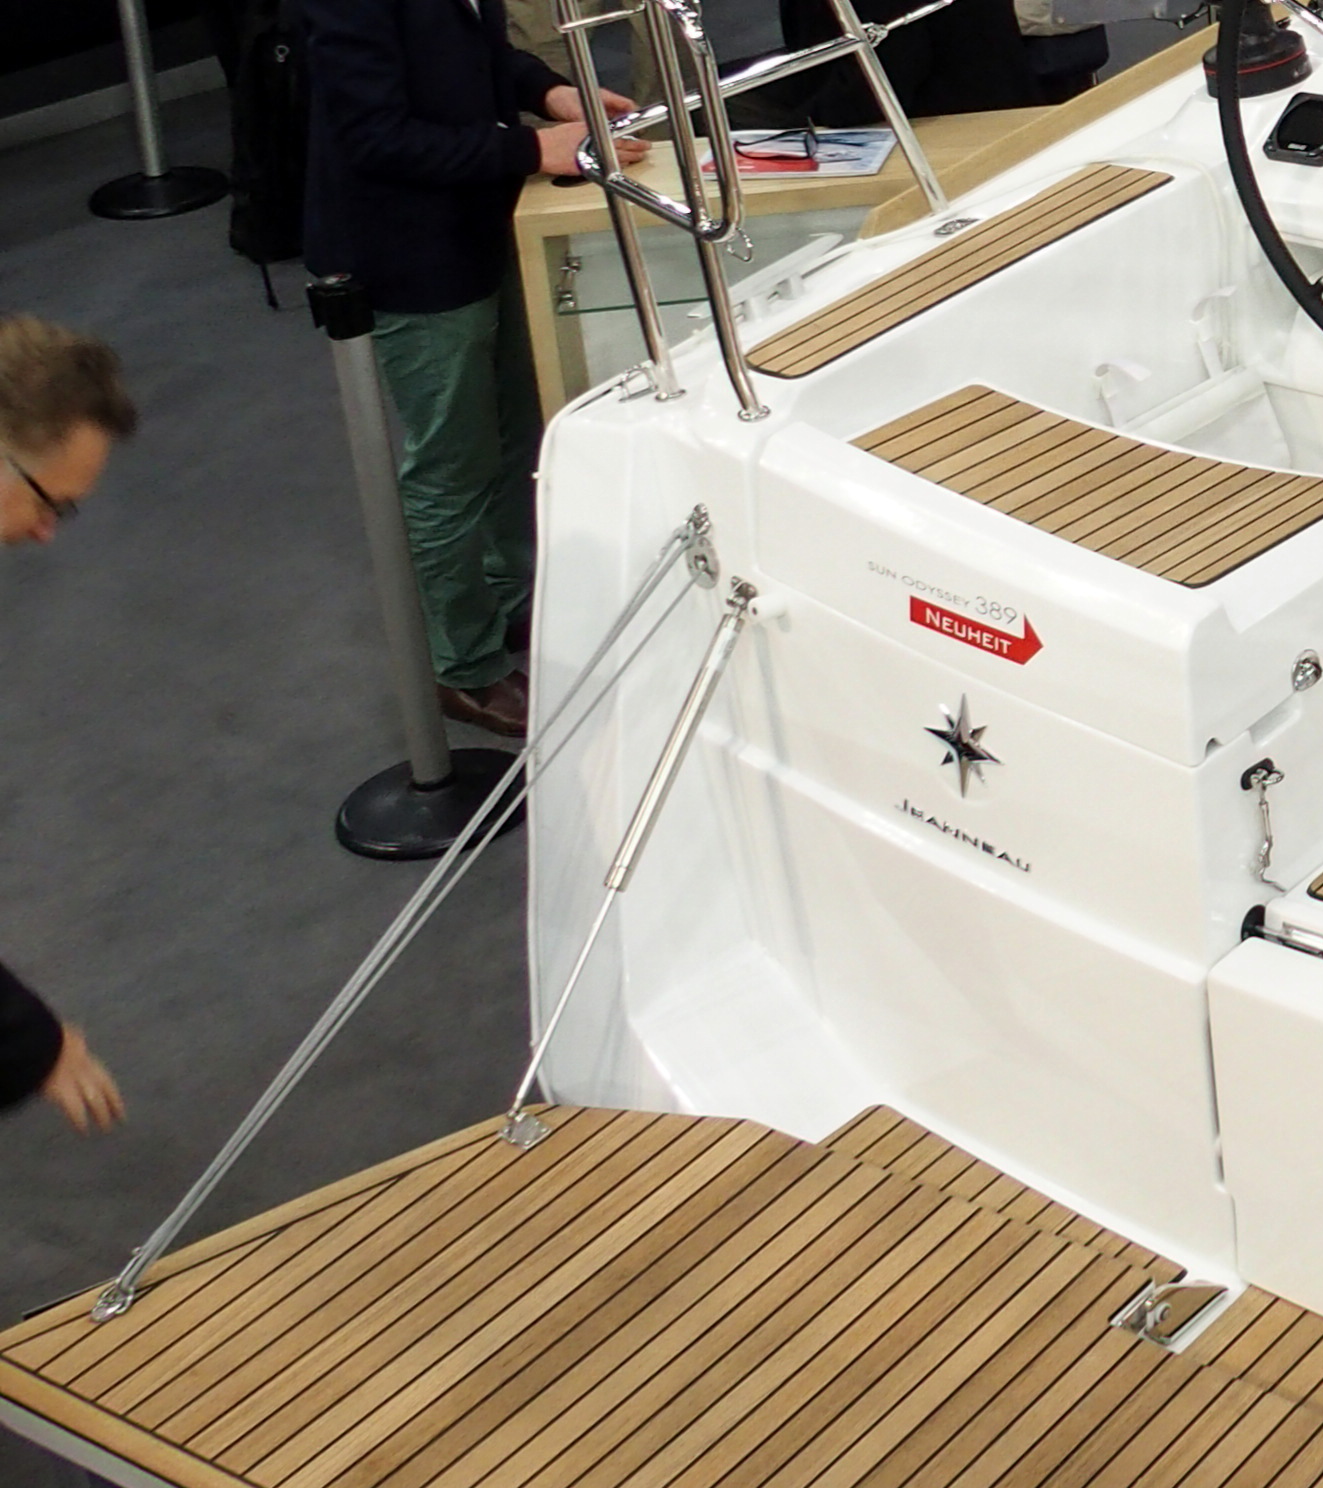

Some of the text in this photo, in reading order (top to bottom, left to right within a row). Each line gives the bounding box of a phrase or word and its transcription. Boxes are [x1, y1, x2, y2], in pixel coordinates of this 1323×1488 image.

[868, 561, 1018, 625] SUN ODYSSEY 389
[925, 607, 1012, 655] NEUHEIT
